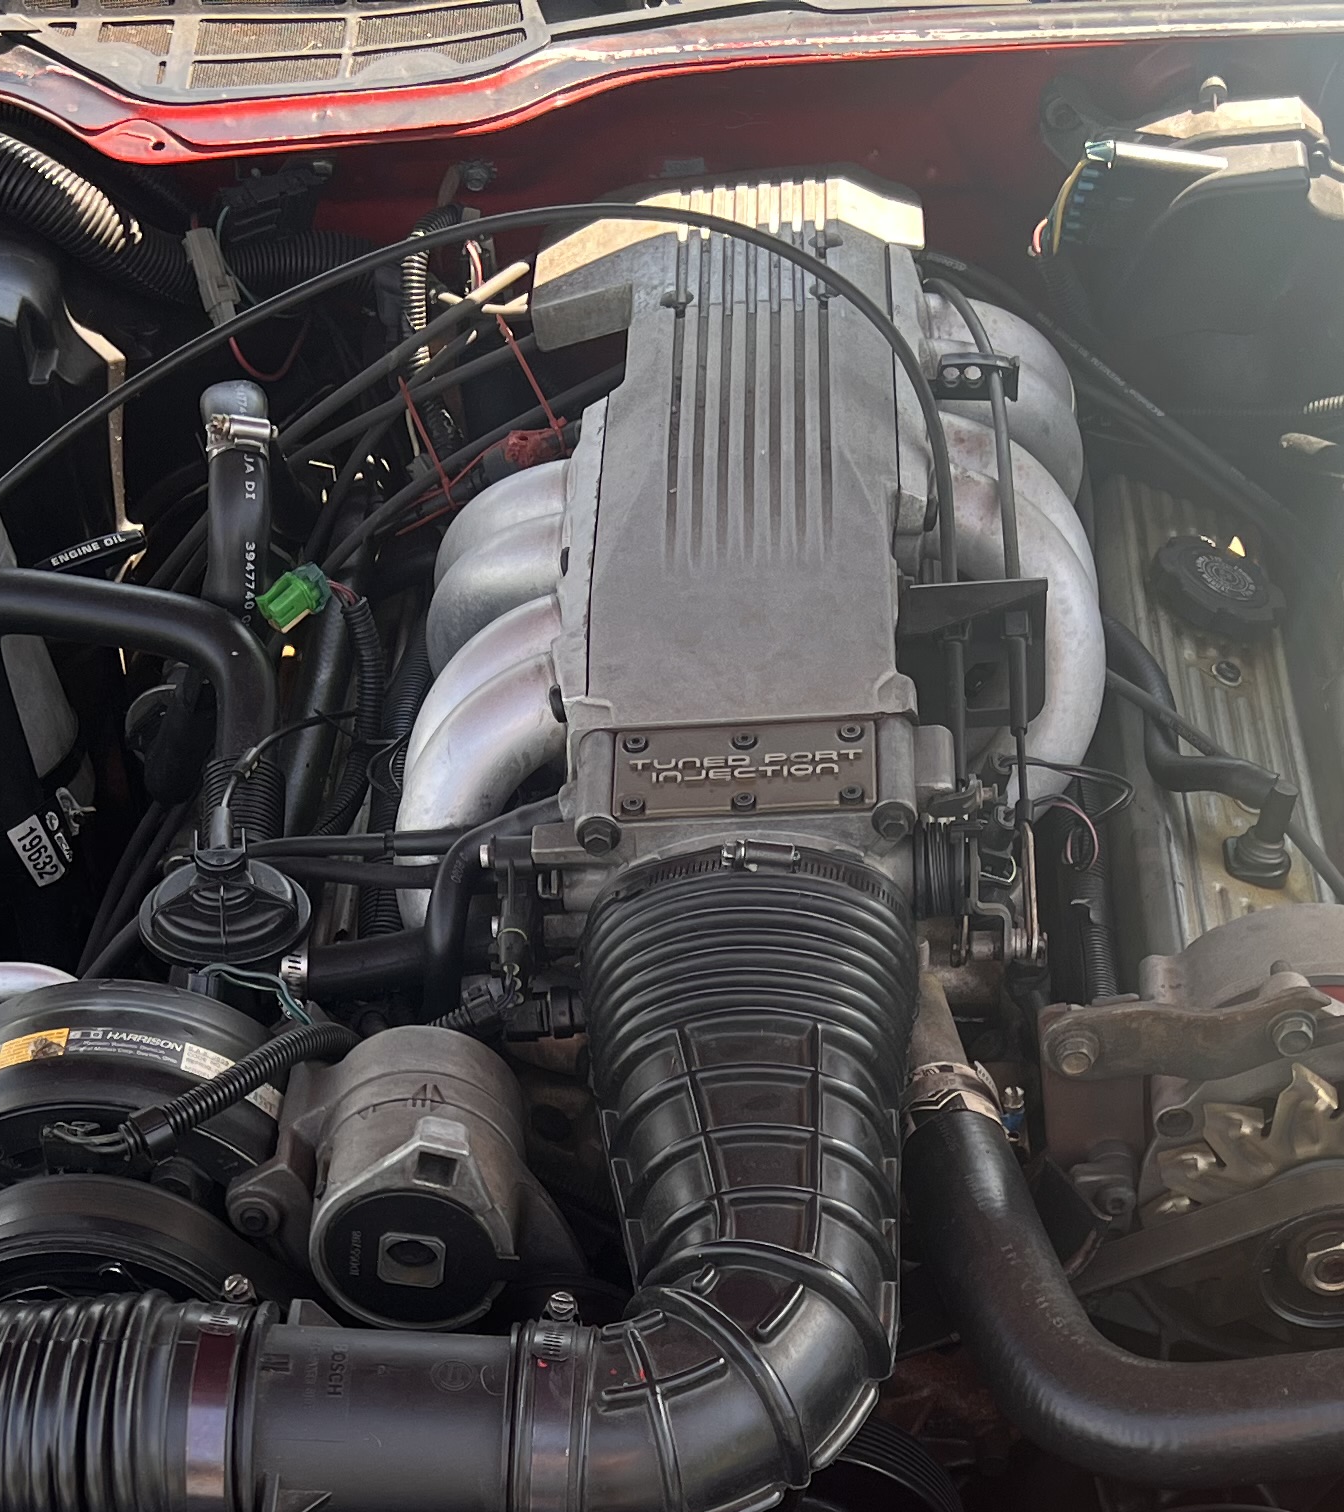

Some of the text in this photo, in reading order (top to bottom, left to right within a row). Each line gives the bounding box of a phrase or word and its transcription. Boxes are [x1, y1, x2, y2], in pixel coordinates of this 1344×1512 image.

[50, 534, 127, 567] ENGINE OIL
[244, 541, 256, 611] 3947740
[629, 749, 863, 770] TUNED PORT
[651, 763, 840, 783] INJECTION
[17, 825, 58, 880] 19632
[105, 1031, 183, 1051] HARRISON
[327, 1343, 350, 1399] BOSCH
